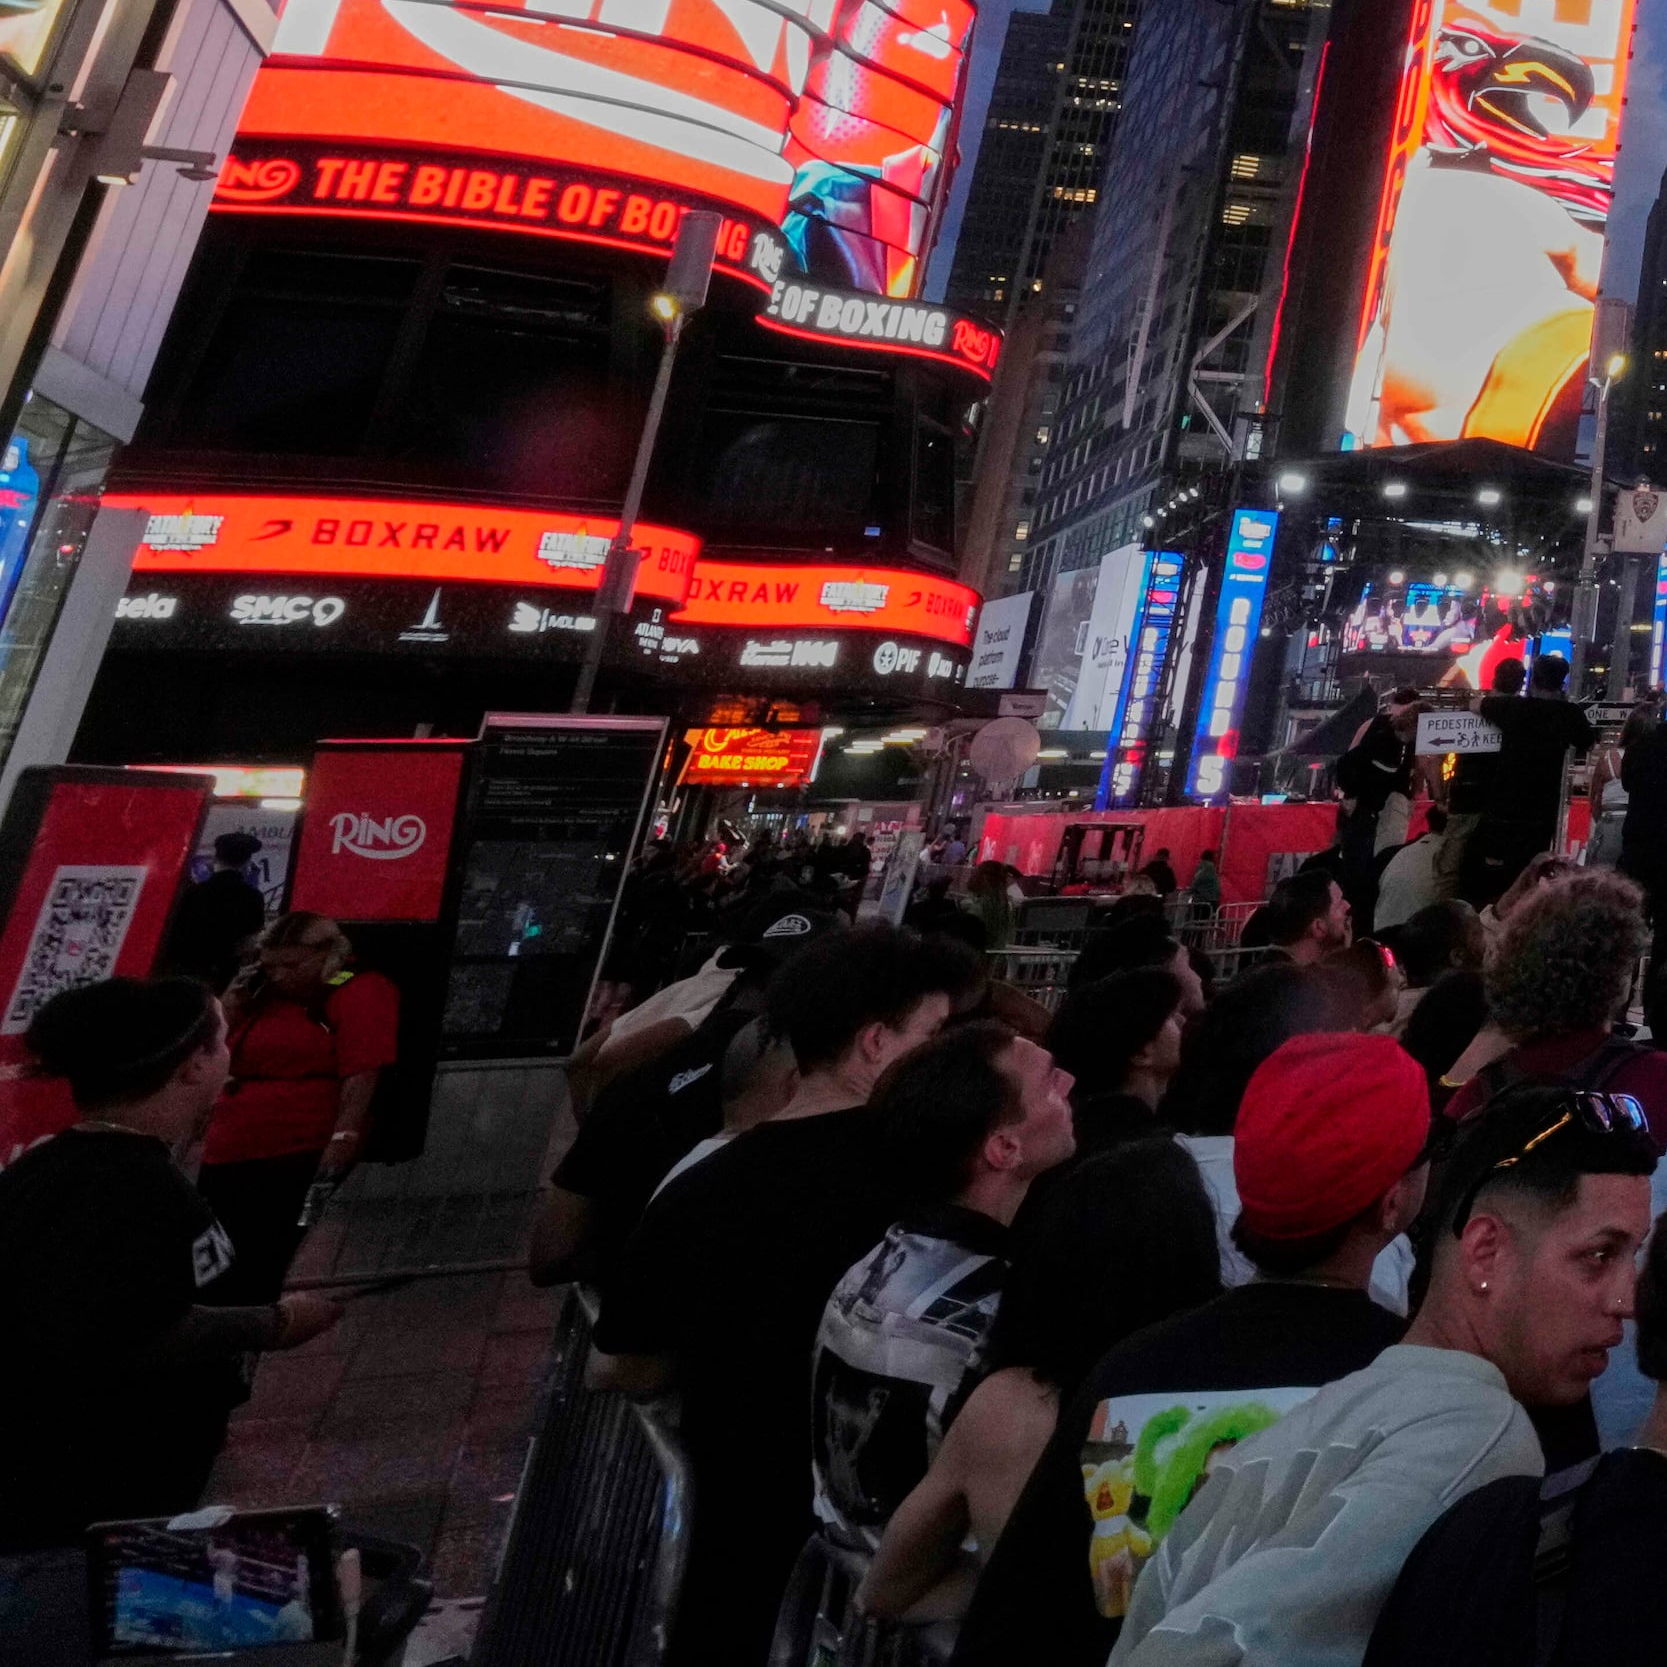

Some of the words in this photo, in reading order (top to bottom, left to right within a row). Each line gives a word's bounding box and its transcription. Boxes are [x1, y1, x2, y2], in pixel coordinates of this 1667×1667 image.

[316, 159, 408, 202] THE
[410, 164, 556, 218] BIBLE
[557, 184, 621, 227] OF
[782, 287, 820, 322] OF
[817, 295, 948, 345] BOXING
[310, 517, 512, 554] BOXRAW
[896, 649, 921, 672] PIF
[1588, 709, 1609, 719] ONE
[697, 753, 741, 771] BAKE
[743, 755, 789, 772] SHOP
[328, 812, 427, 860] RING
